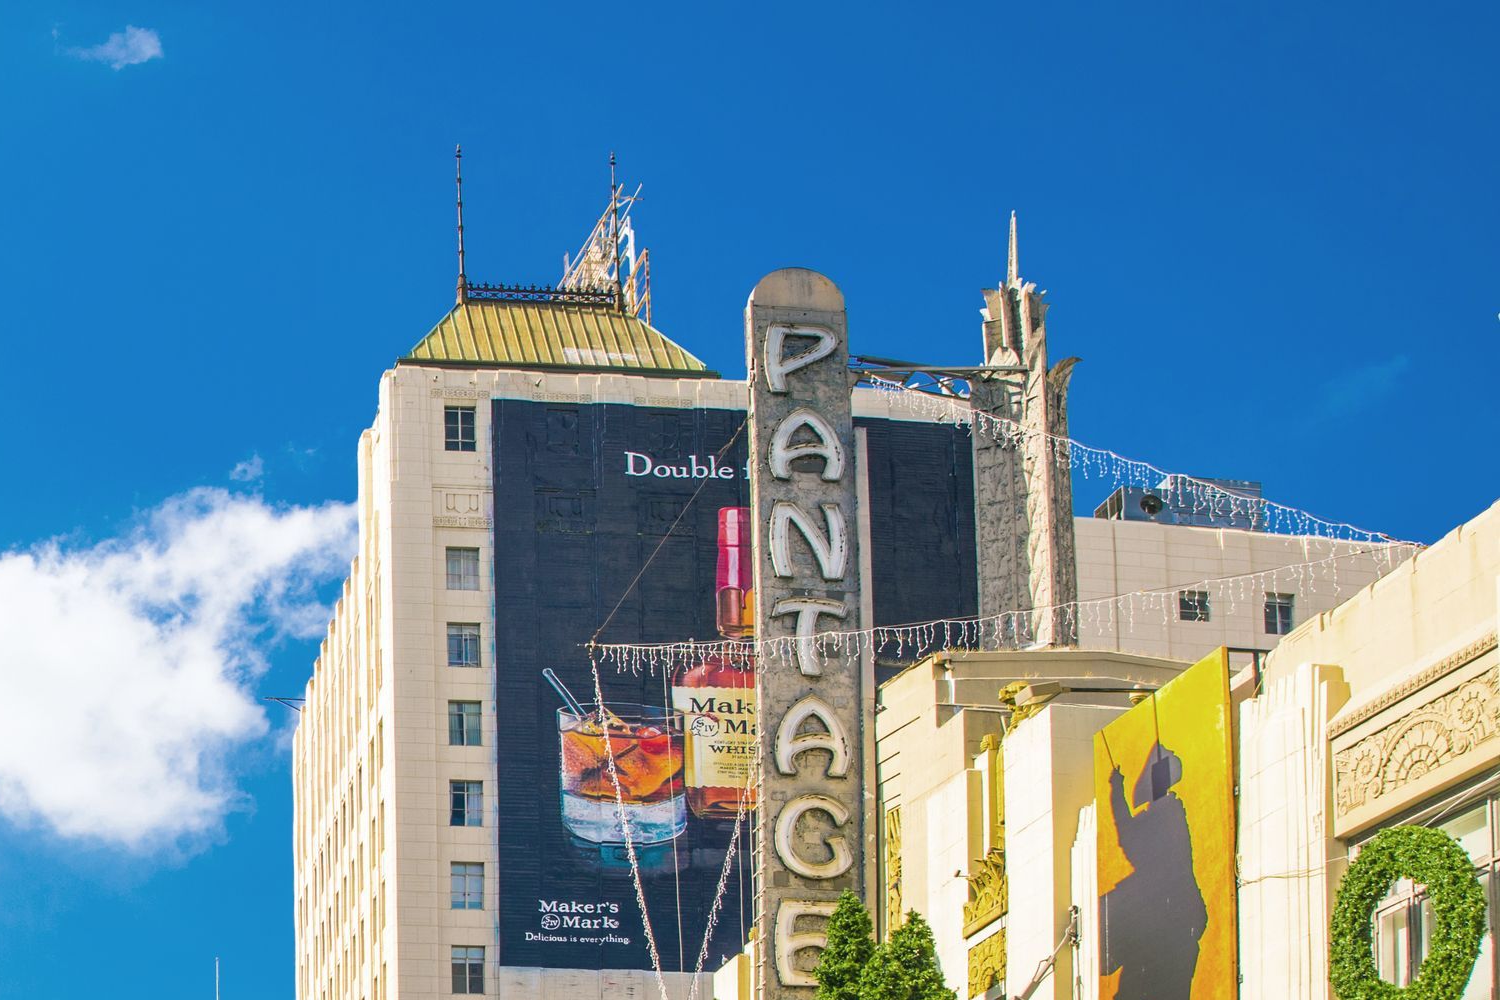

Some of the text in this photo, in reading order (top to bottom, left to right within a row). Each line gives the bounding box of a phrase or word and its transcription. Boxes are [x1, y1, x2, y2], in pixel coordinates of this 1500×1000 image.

[624, 451, 734, 479] Double
[689, 697, 756, 714] Mak
[538, 899, 619, 914] Maker's
[525, 932, 568, 943] Delicious
[570, 935, 577, 943] is
